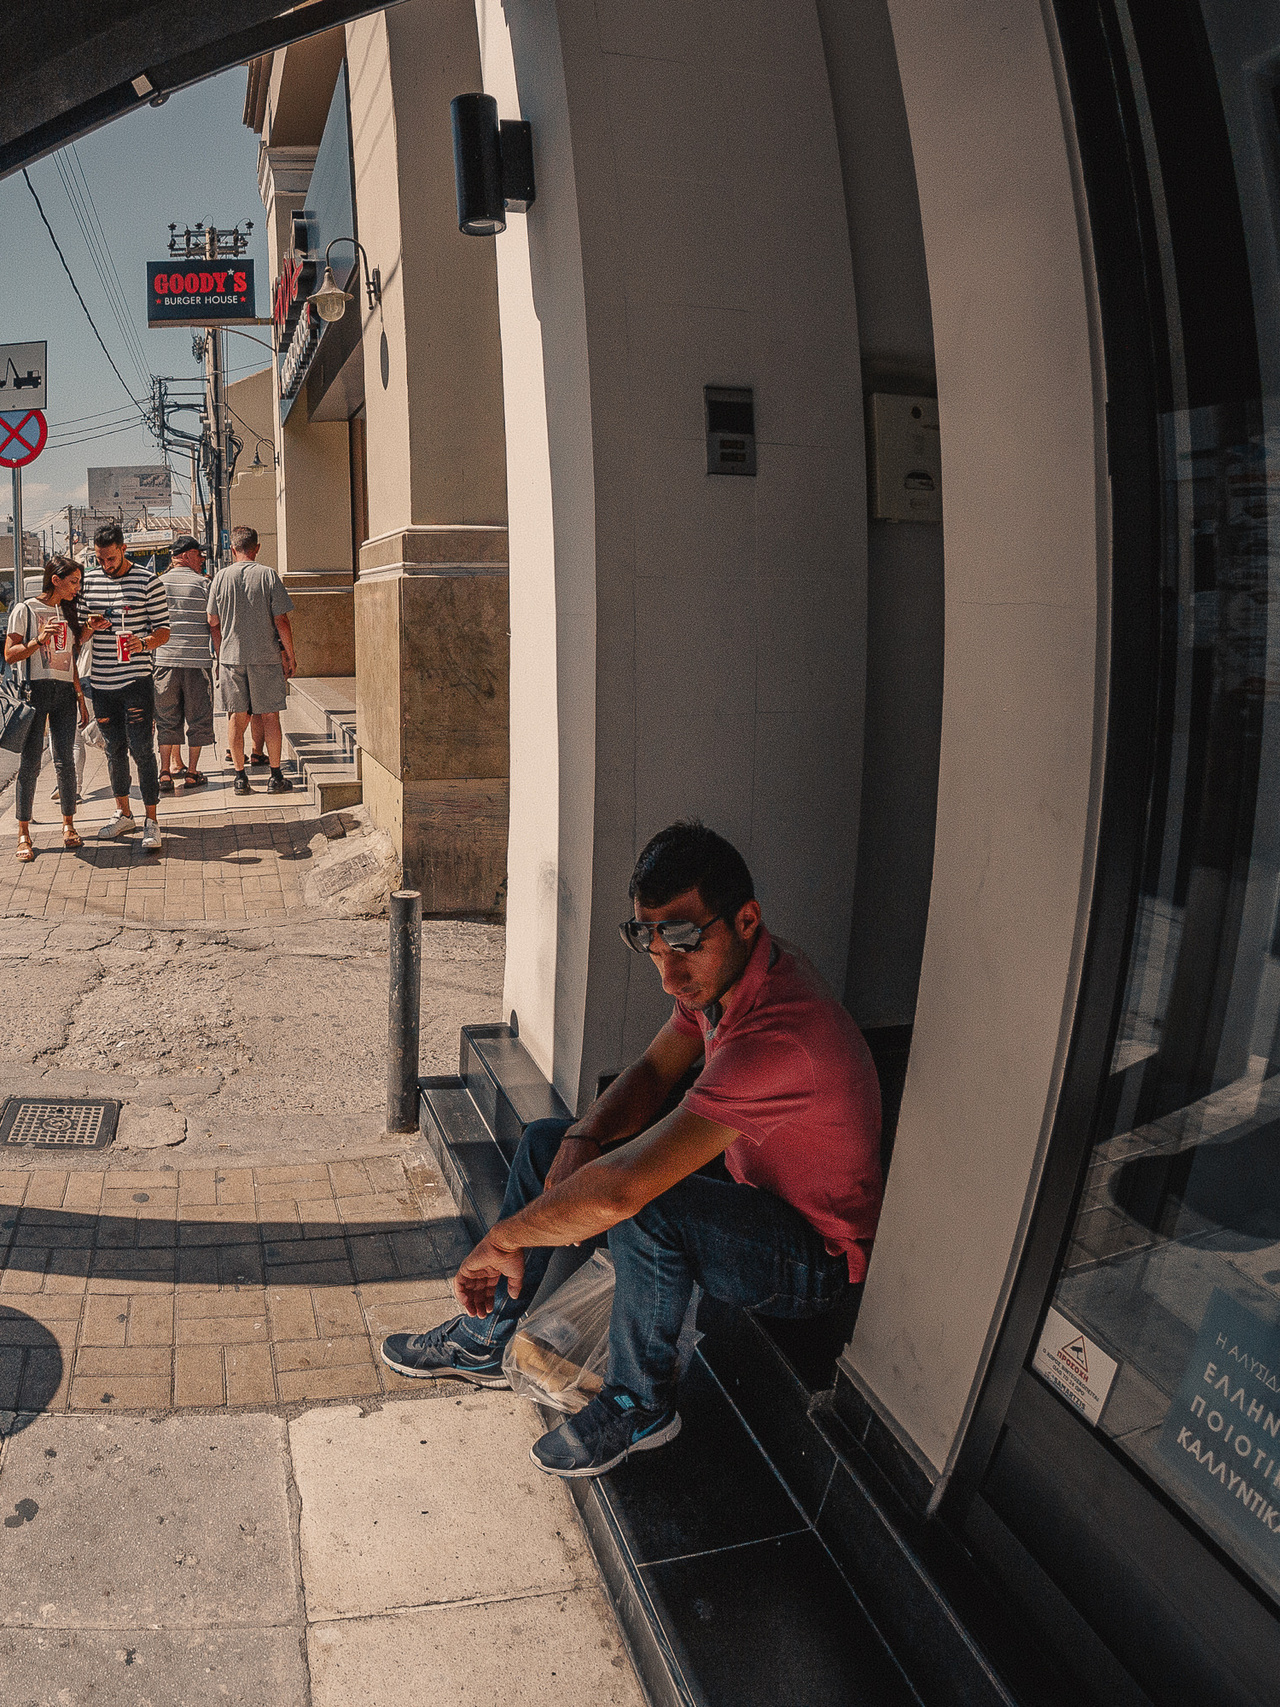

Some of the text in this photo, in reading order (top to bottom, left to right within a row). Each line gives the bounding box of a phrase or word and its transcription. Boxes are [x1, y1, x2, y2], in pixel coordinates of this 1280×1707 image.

[154, 271, 247, 295] GOODY'S
[164, 295, 238, 306] BURGER HOUSE
[1056, 1350, 1089, 1382] ΠΡΟΣΟΧΗ
[1215, 1331, 1280, 1393] Η ΑΛΥΣΙΔ
[1203, 1361, 1280, 1438] ΕΛΛΗΝ
